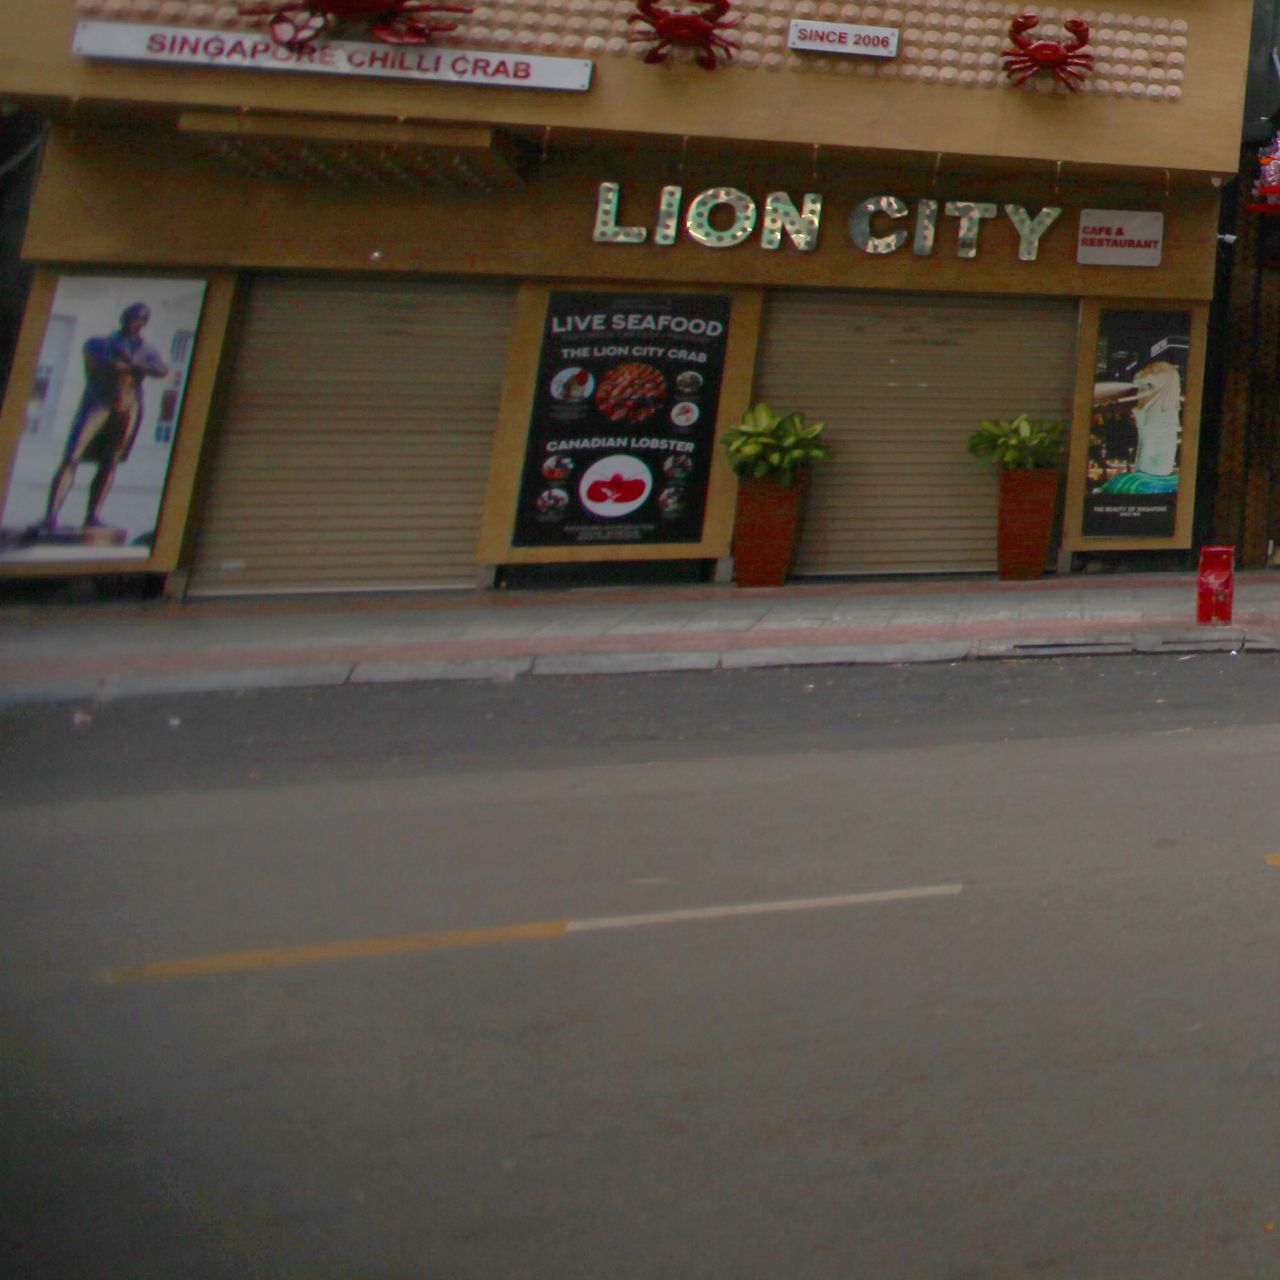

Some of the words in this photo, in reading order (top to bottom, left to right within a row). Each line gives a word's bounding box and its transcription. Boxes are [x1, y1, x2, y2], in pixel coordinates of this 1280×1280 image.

[797, 28, 848, 45] SINCE
[852, 33, 891, 49] 2006
[347, 47, 441, 74] CHILLI
[450, 55, 533, 81] CRAB
[593, 182, 823, 251] LION
[848, 195, 1063, 262] CITY
[1082, 226, 1112, 235] CAFE
[1115, 227, 1125, 237] &
[1081, 237, 1160, 250] RESTAURANT
[552, 314, 607, 333] LIVE
[611, 314, 723, 337] SEAFOOD
[561, 347, 591, 359] THE
[593, 345, 630, 357] LION
[632, 346, 666, 358] CITY
[667, 348, 708, 363] CRAB
[546, 437, 629, 452] CANADIAN
[631, 437, 696, 453] LOBSTER
